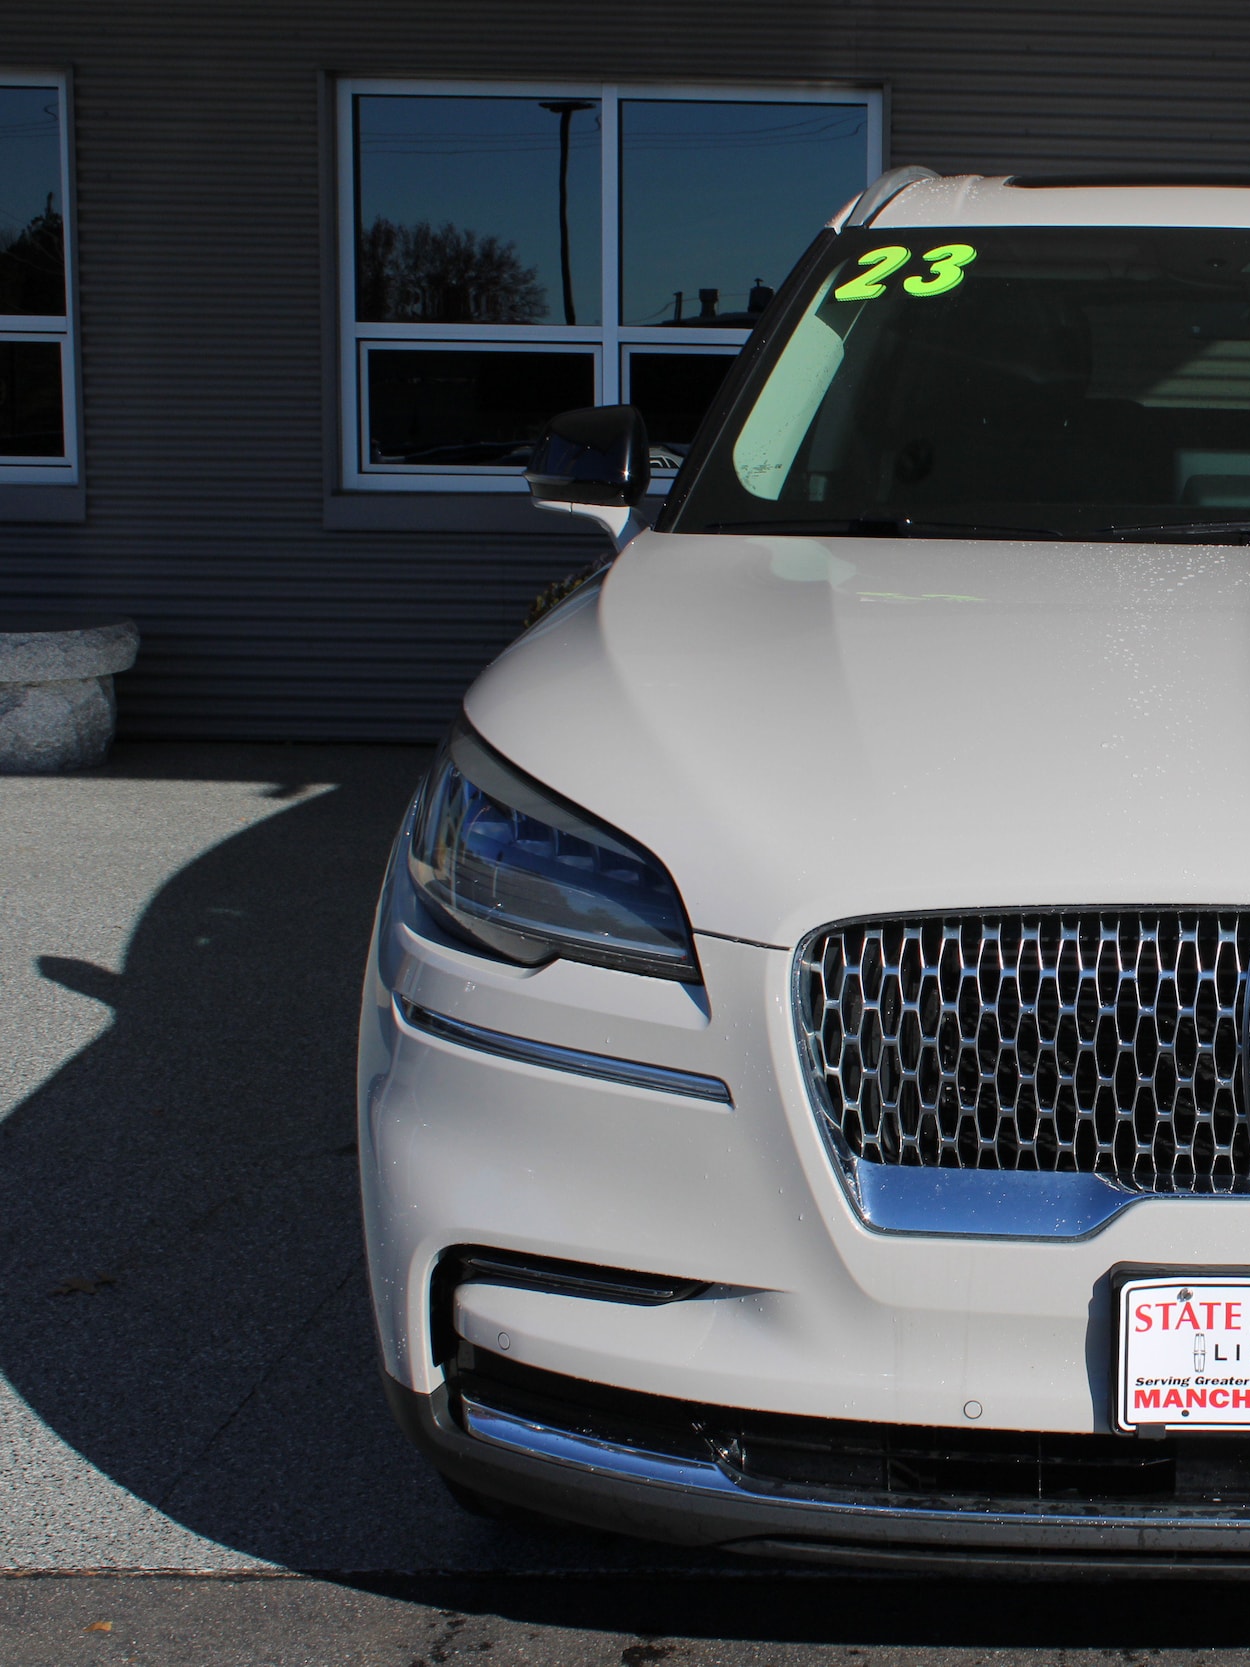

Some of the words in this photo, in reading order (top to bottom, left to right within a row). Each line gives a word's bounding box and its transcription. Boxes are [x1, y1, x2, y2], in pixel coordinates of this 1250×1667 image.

[834, 244, 977, 301] 23
[1135, 1301, 1242, 1333] STATE
[1135, 1376, 1190, 1387] Serving
[1195, 1376, 1248, 1386] Greater
